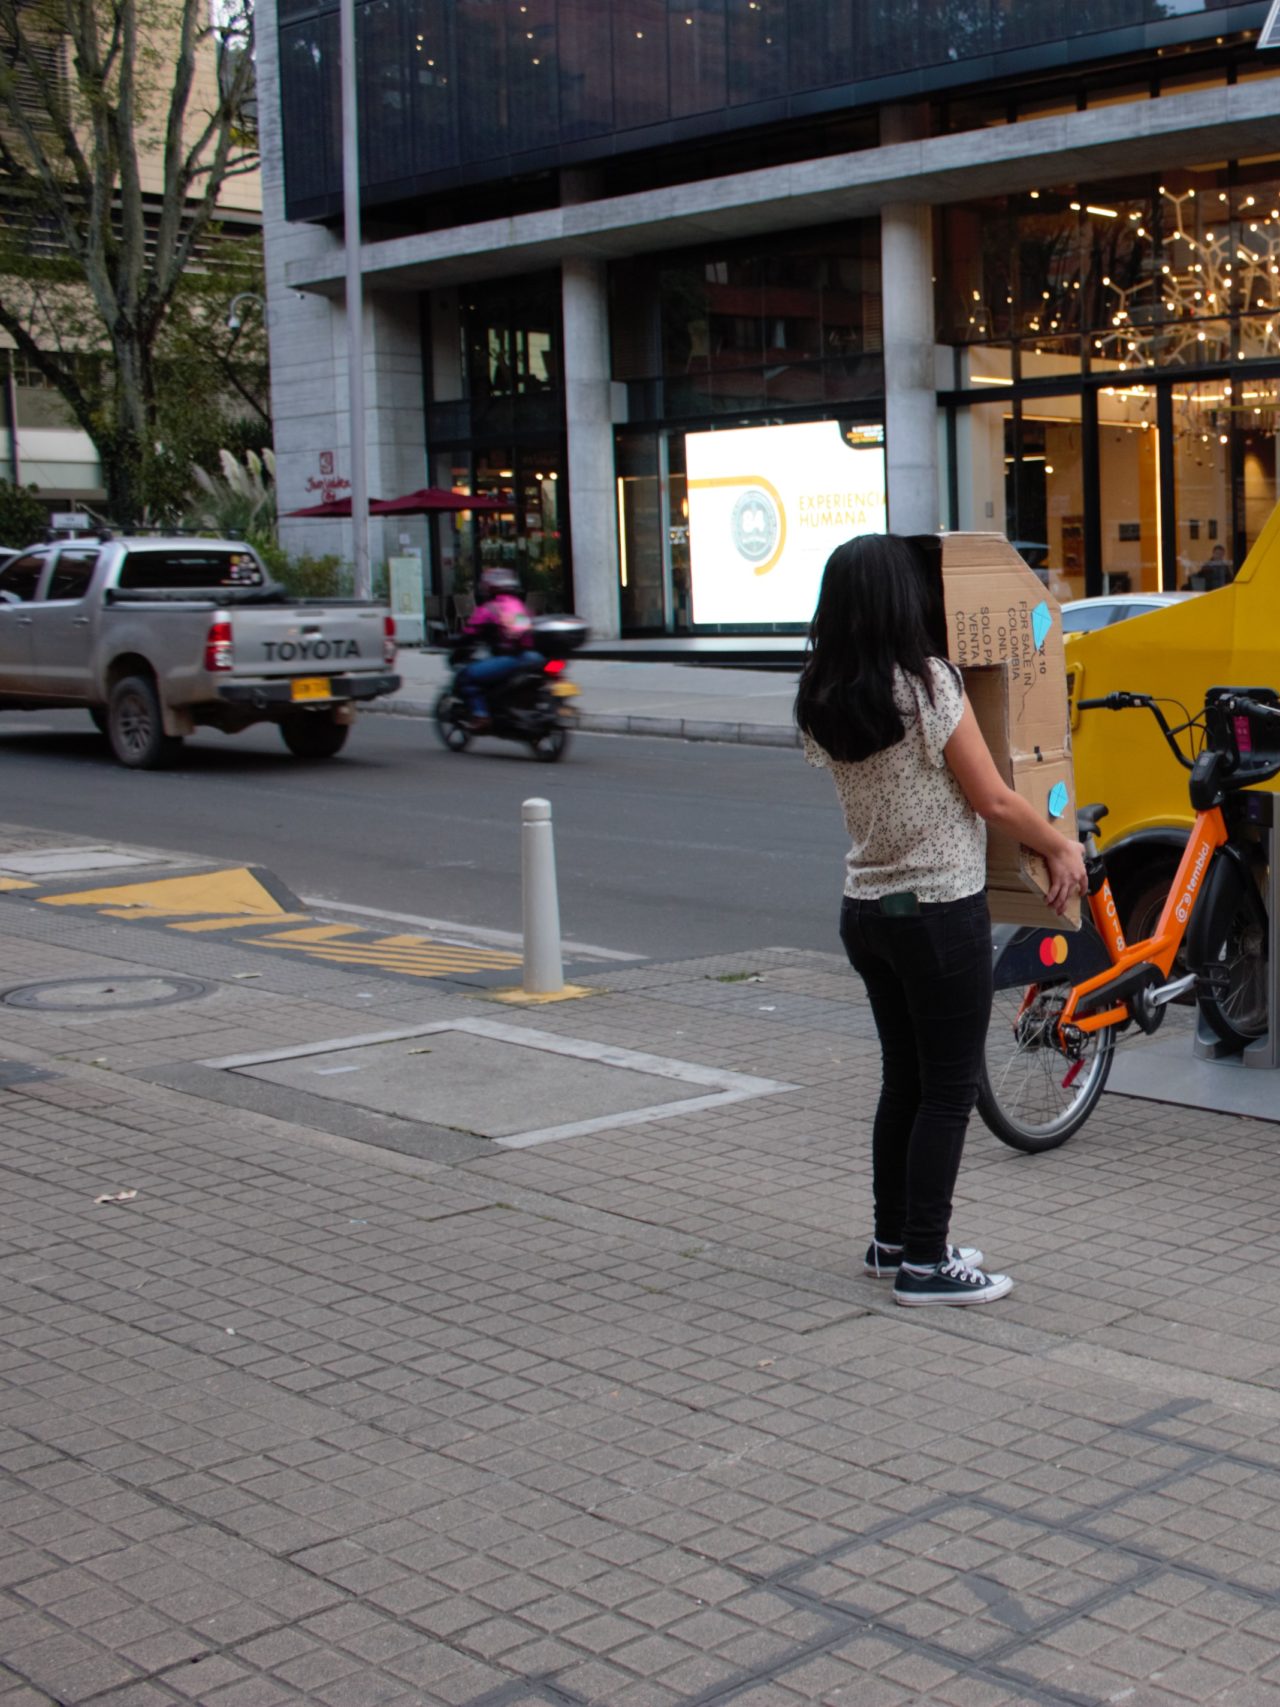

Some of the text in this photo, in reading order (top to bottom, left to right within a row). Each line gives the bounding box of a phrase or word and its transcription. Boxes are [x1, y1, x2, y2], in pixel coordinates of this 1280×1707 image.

[799, 510, 868, 528] HUMANA
[968, 613, 980, 660] VENTA
[980, 606, 992, 646] SOLO
[996, 626, 1008, 661] ONLY
[1007, 607, 1021, 682] COLOMBIA
[1018, 600, 1032, 687] FOR SALE IN
[262, 639, 362, 662] TOYOTA
[1186, 841, 1211, 893] tembici
